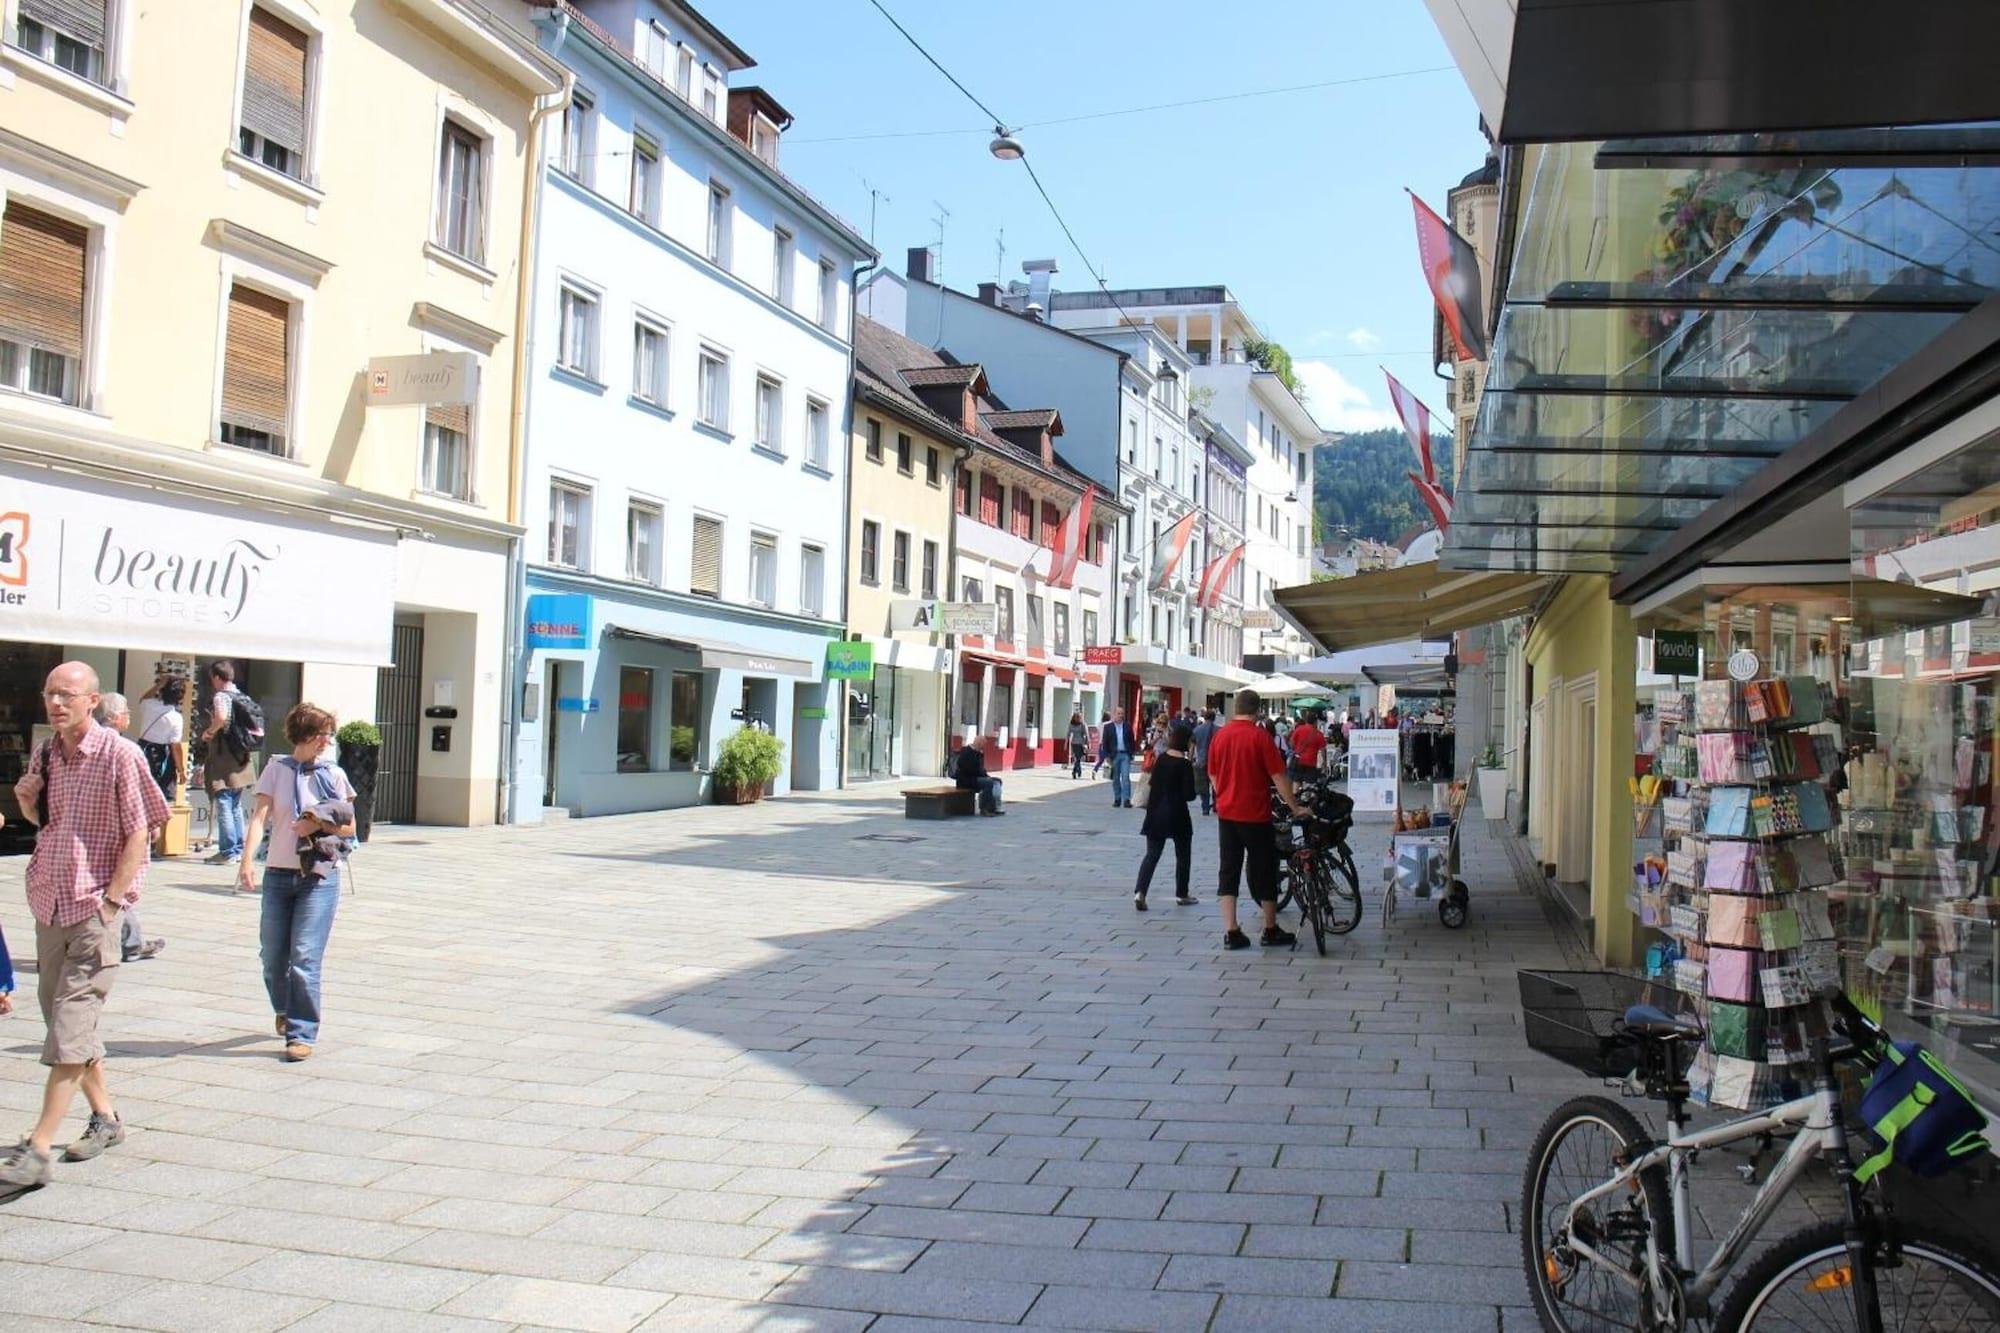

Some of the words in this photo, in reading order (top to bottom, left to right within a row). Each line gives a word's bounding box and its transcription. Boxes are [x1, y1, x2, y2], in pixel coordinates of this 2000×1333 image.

[94, 527, 281, 624] beauty
[94, 593, 212, 623] STORE
[1087, 648, 1119, 658] PRAEG
